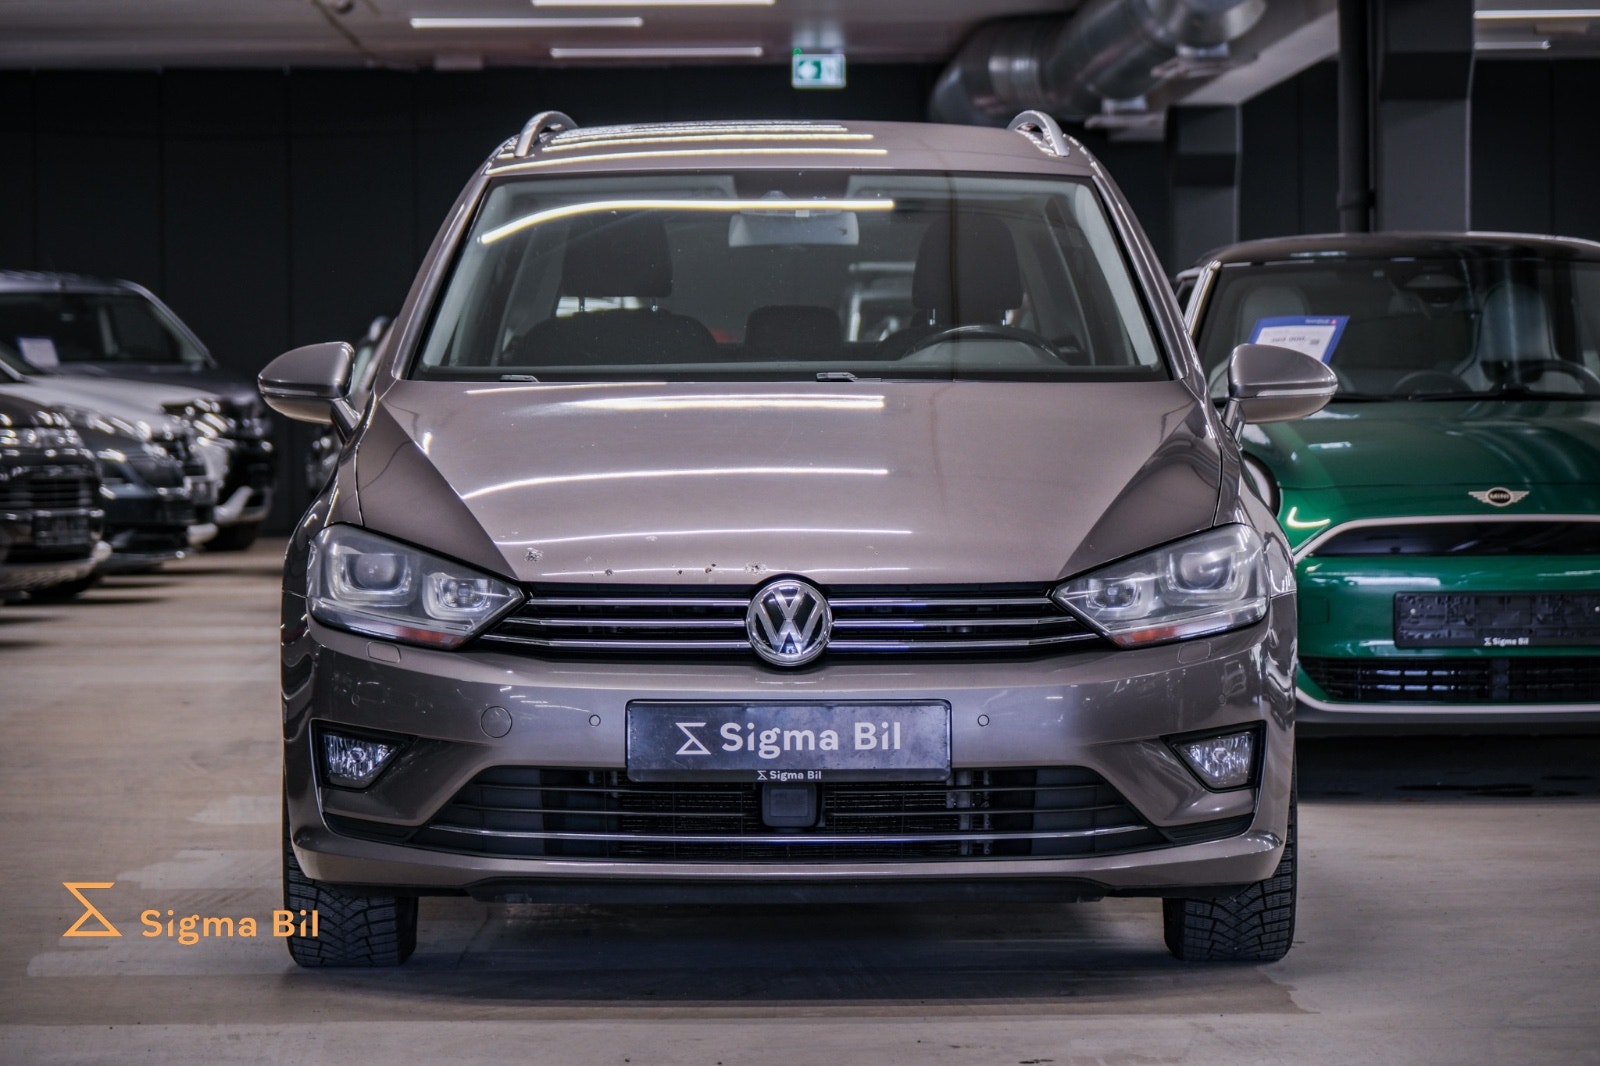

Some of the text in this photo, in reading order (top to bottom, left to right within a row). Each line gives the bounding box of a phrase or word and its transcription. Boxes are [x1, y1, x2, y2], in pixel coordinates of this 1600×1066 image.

[752, 585, 825, 658] VW
[1492, 637, 1517, 647] Sigma
[720, 721, 901, 759] Sigma Bil
[769, 770, 822, 781] Sigma Bil
